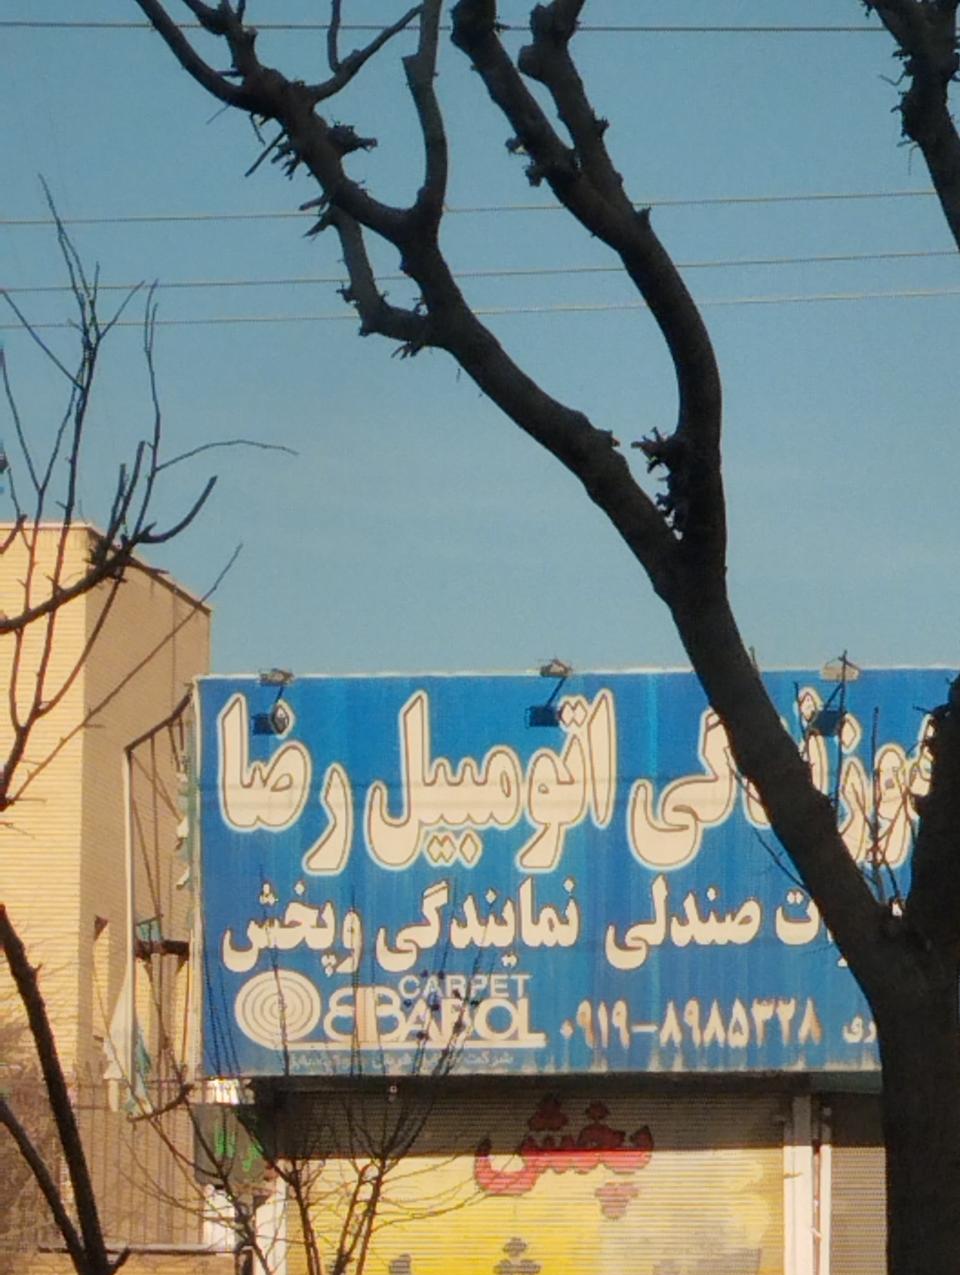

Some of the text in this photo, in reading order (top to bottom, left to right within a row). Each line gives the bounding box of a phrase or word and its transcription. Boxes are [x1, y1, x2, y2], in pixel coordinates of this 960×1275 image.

[217, 692, 356, 874] رضا
[363, 687, 618, 873] اتومبیل
[376, 876, 581, 973] نمایندگی
[604, 873, 764, 971] صندلی
[399, 973, 532, 999] CARPET
